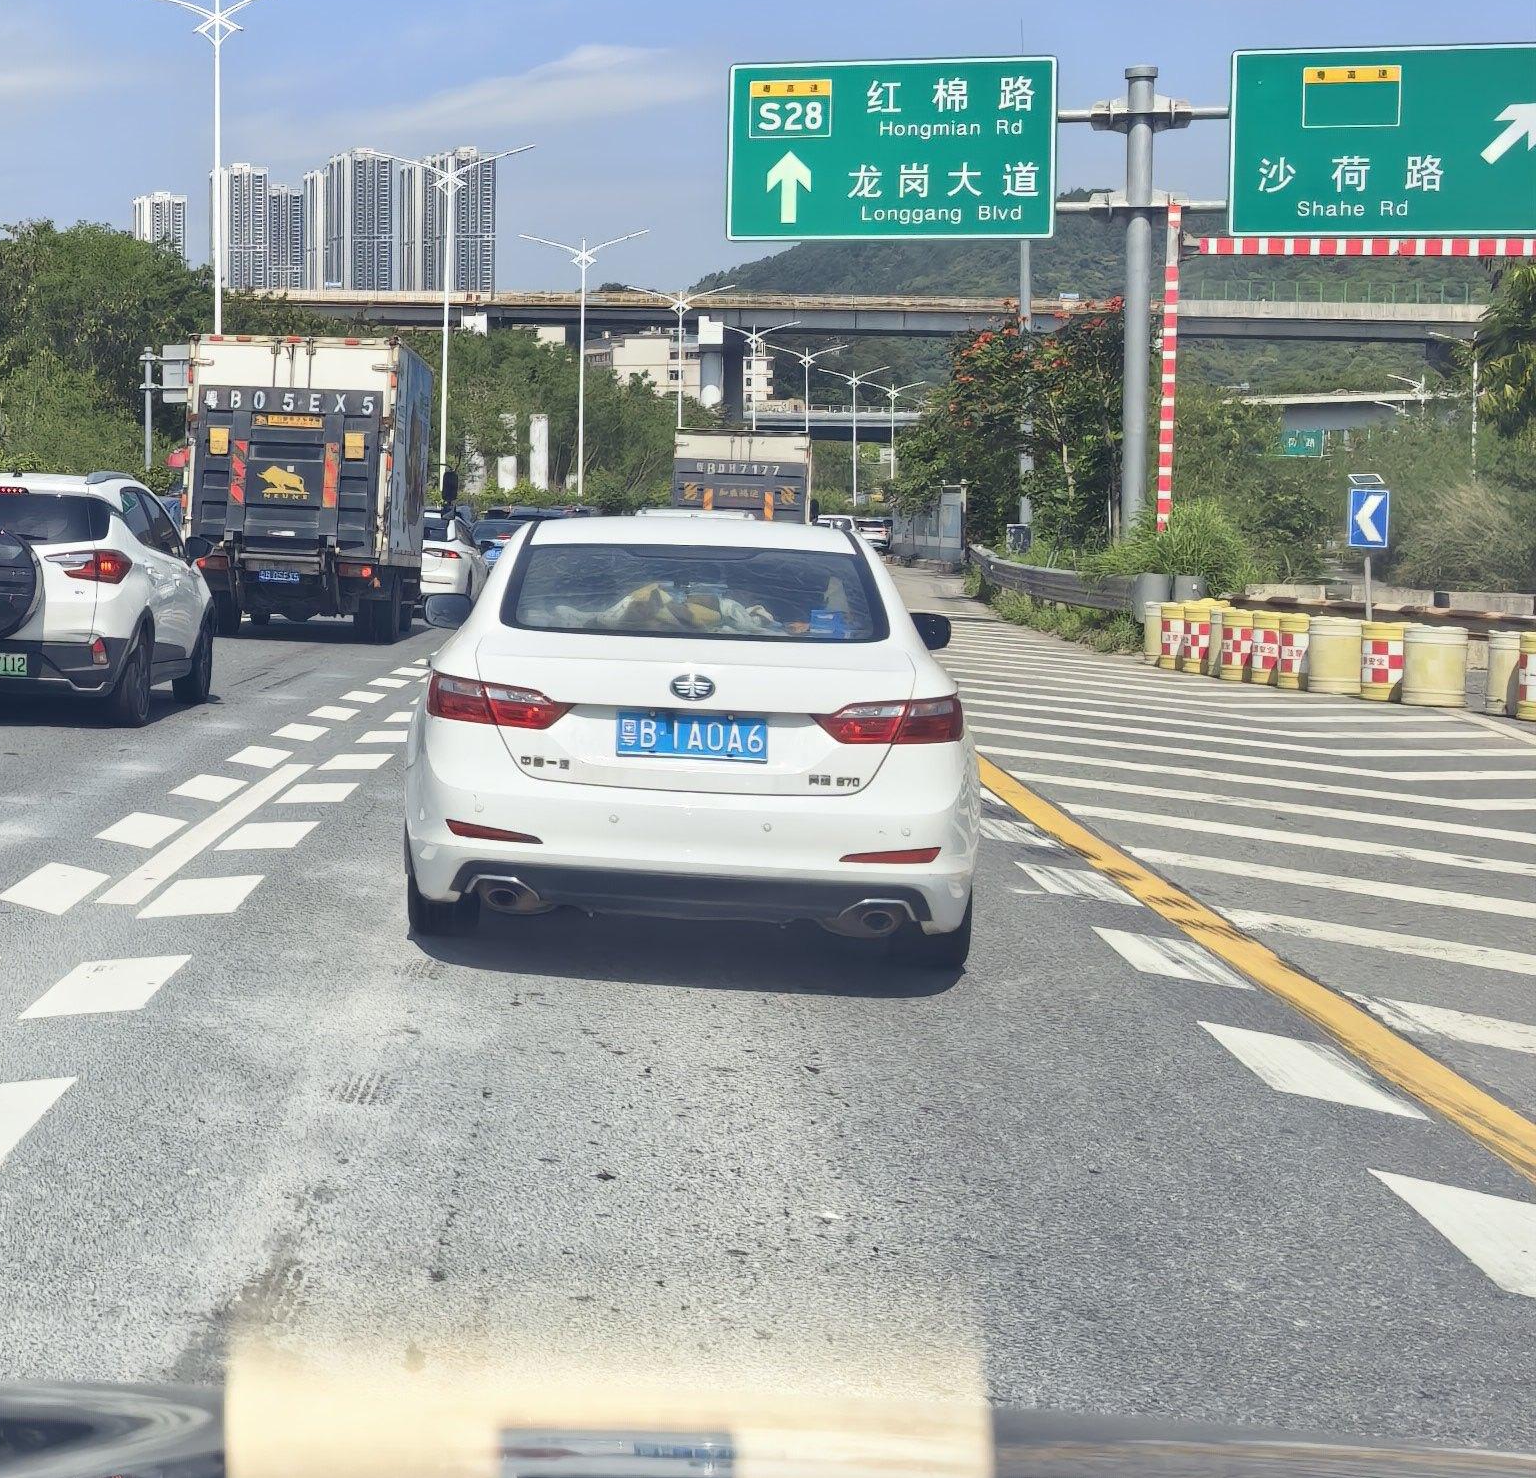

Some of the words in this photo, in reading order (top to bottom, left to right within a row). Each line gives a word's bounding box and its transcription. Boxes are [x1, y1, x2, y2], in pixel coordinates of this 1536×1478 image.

[866, 75, 1035, 114] 红棉路
[758, 101, 823, 131] S28
[879, 120, 981, 140] Hongmian
[996, 119, 1023, 136] Rd
[847, 161, 1040, 199] 龙岗大道
[1258, 154, 1444, 193] 沙荷路
[861, 206, 962, 225] Longgang
[978, 205, 1022, 221] Blvd
[1297, 200, 1365, 217] Shahe
[1380, 200, 1408, 217] Rd
